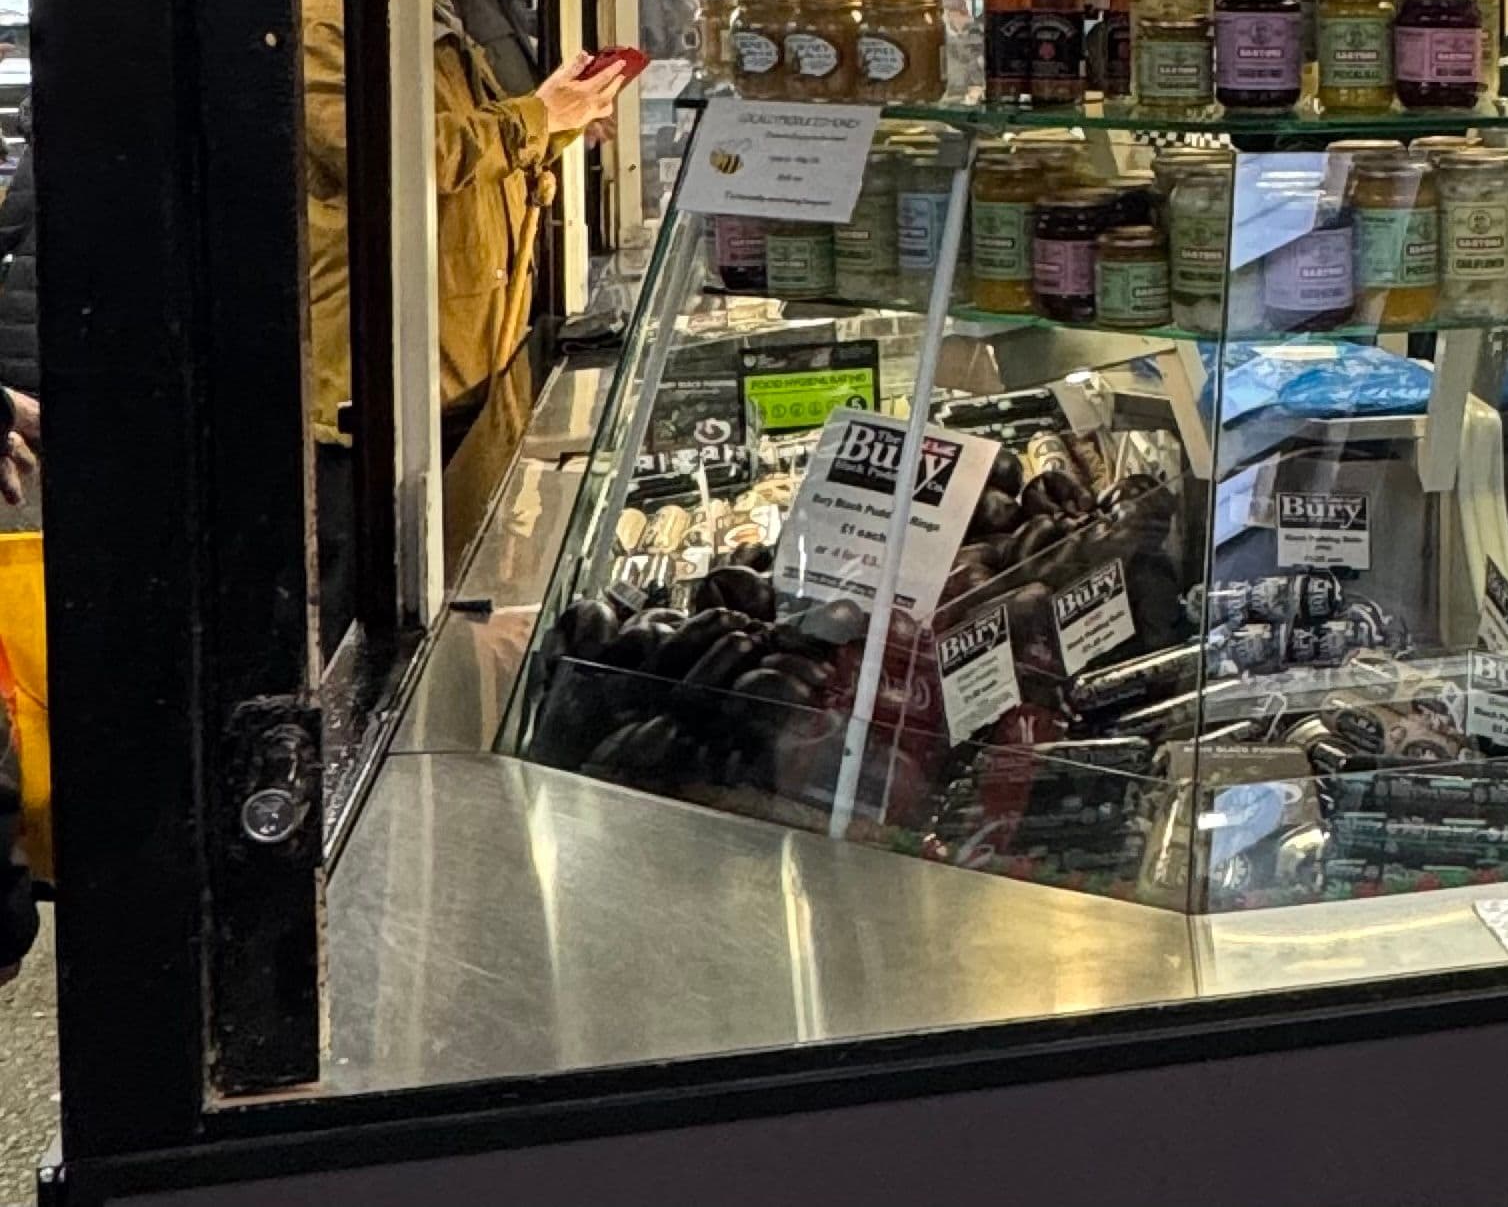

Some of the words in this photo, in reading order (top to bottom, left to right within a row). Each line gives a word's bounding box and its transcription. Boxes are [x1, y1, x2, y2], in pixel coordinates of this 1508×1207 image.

[838, 422, 952, 496] Buy
[1279, 494, 1364, 529] Bury
[1058, 566, 1119, 620] Bury
[940, 615, 1003, 666] Bury
